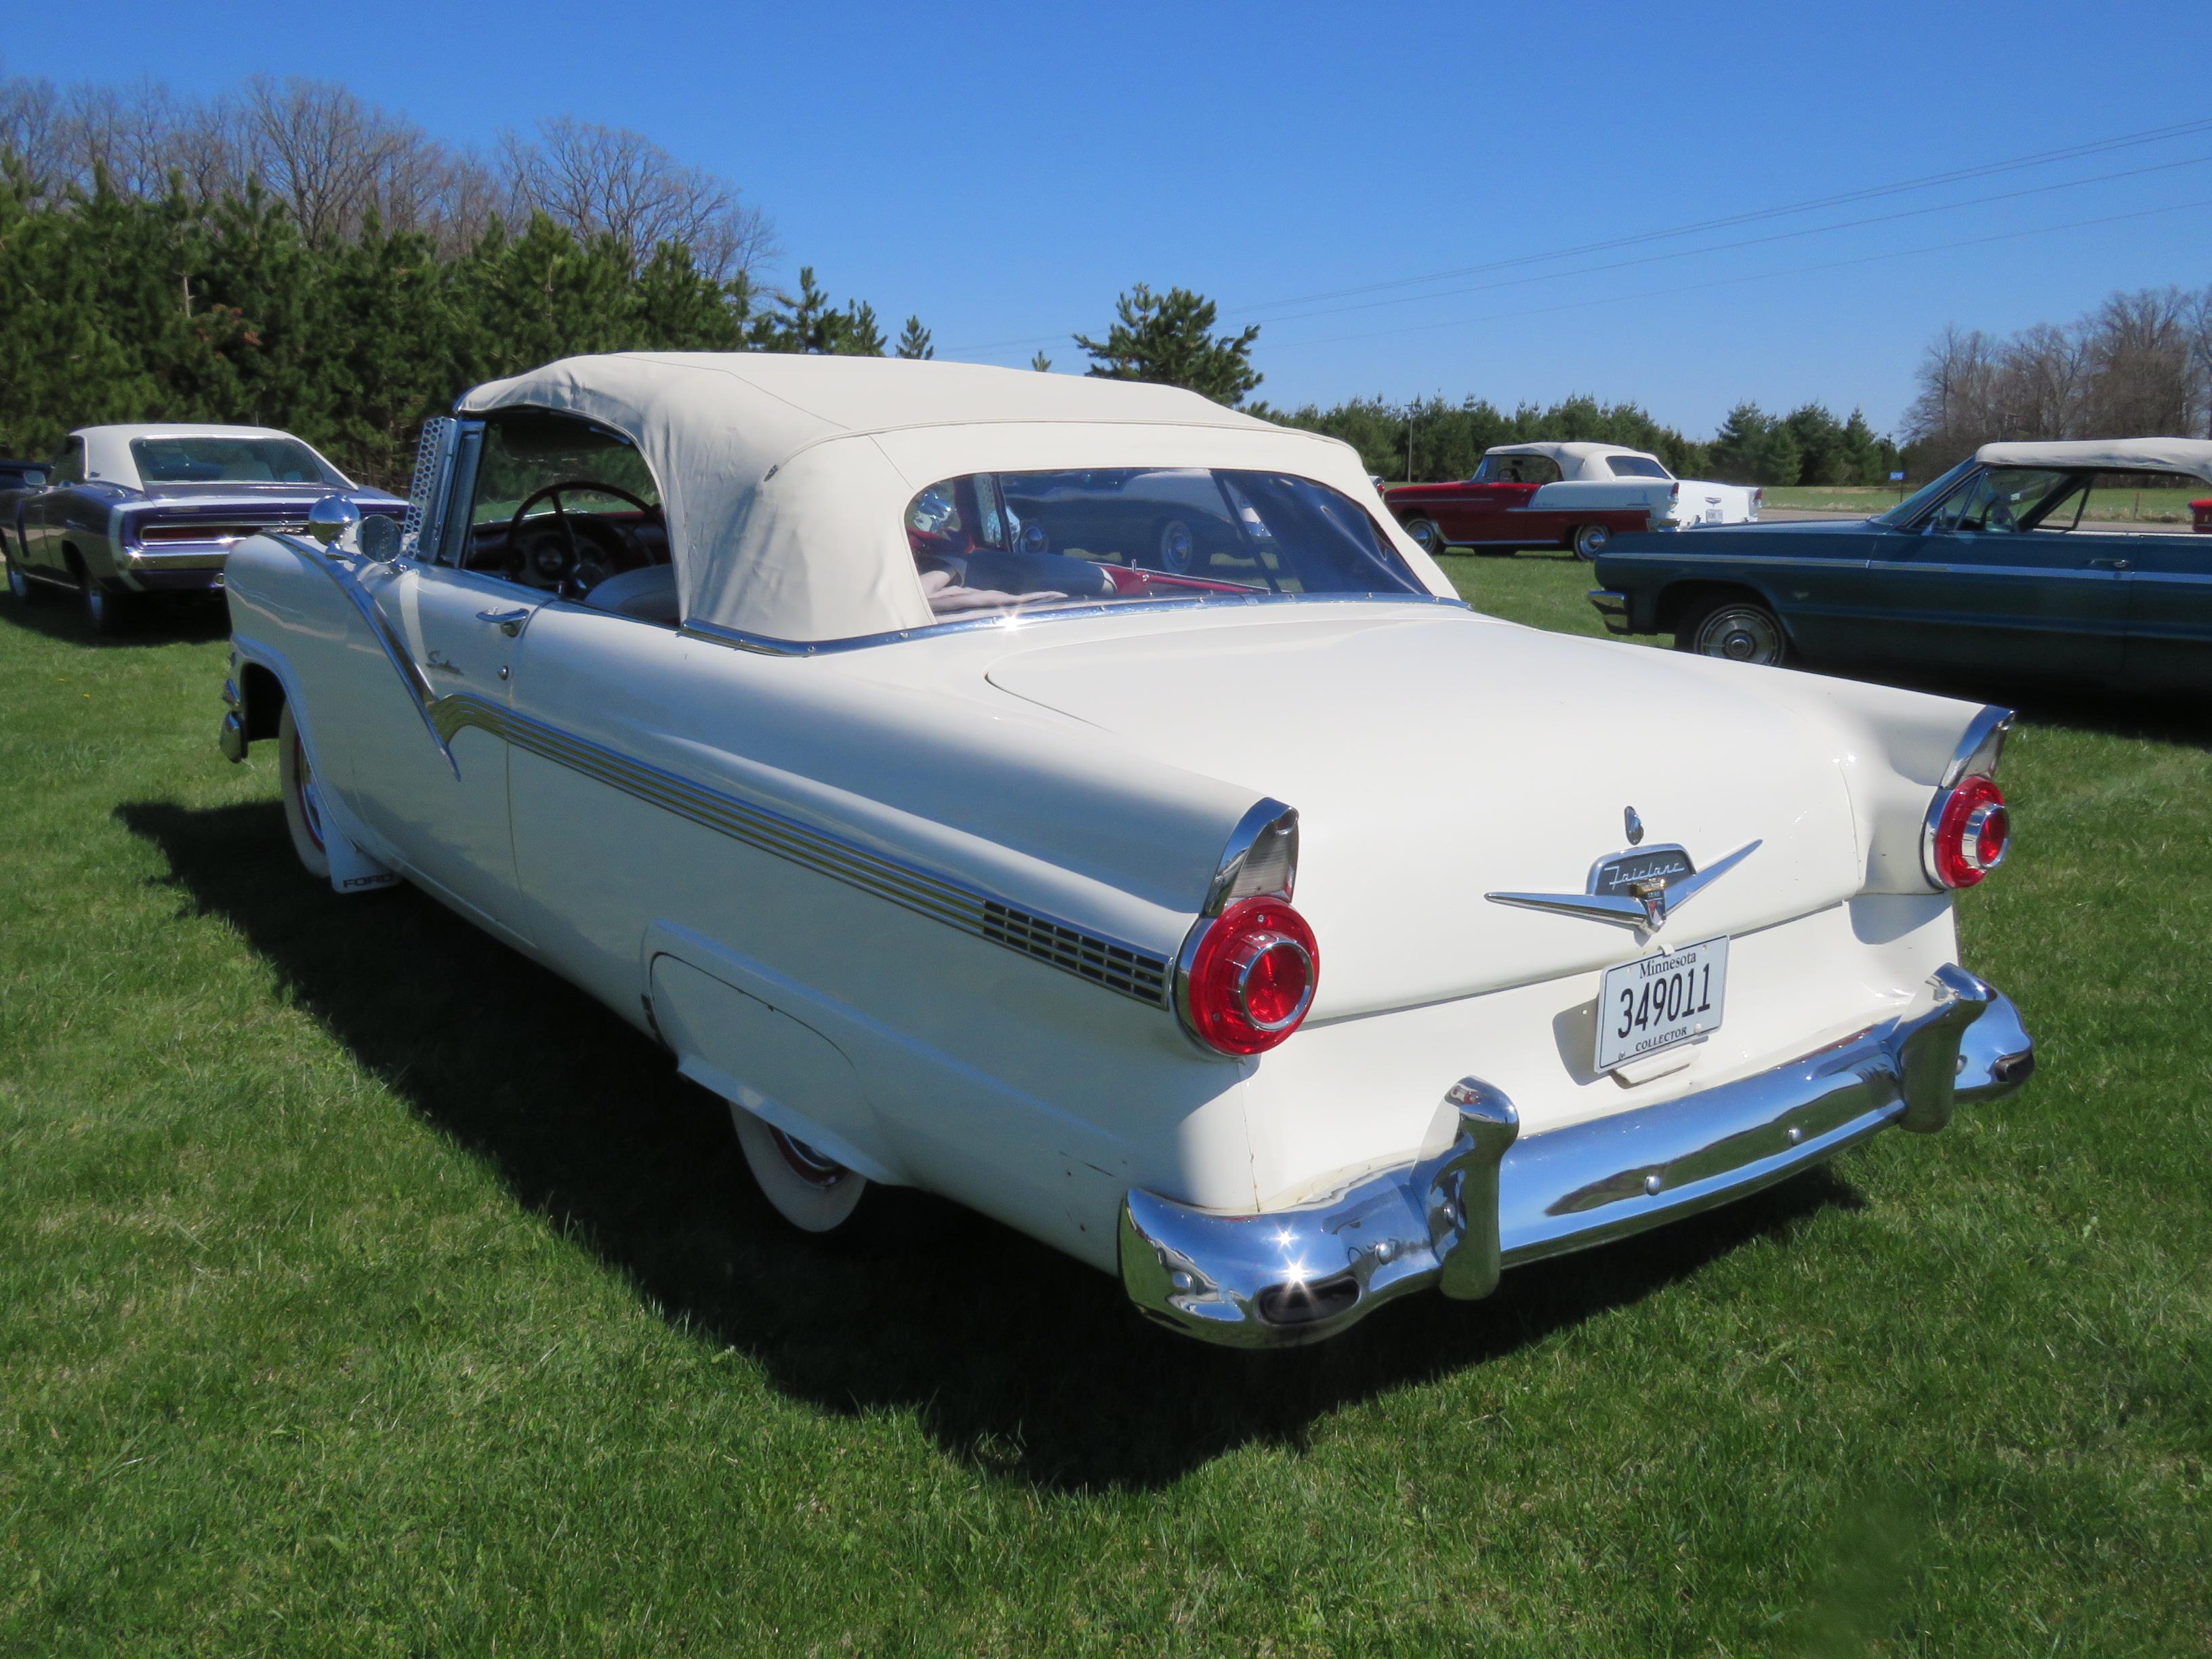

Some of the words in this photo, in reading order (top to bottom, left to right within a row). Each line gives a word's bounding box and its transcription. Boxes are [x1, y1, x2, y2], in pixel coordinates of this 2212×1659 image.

[343, 874, 393, 887] FORD
[1604, 863, 1685, 890] Fairlane
[1639, 952, 1696, 979] Minnesota
[1618, 963, 1711, 1038] 349011
[1635, 1026, 1687, 1052] COLLECTOR
